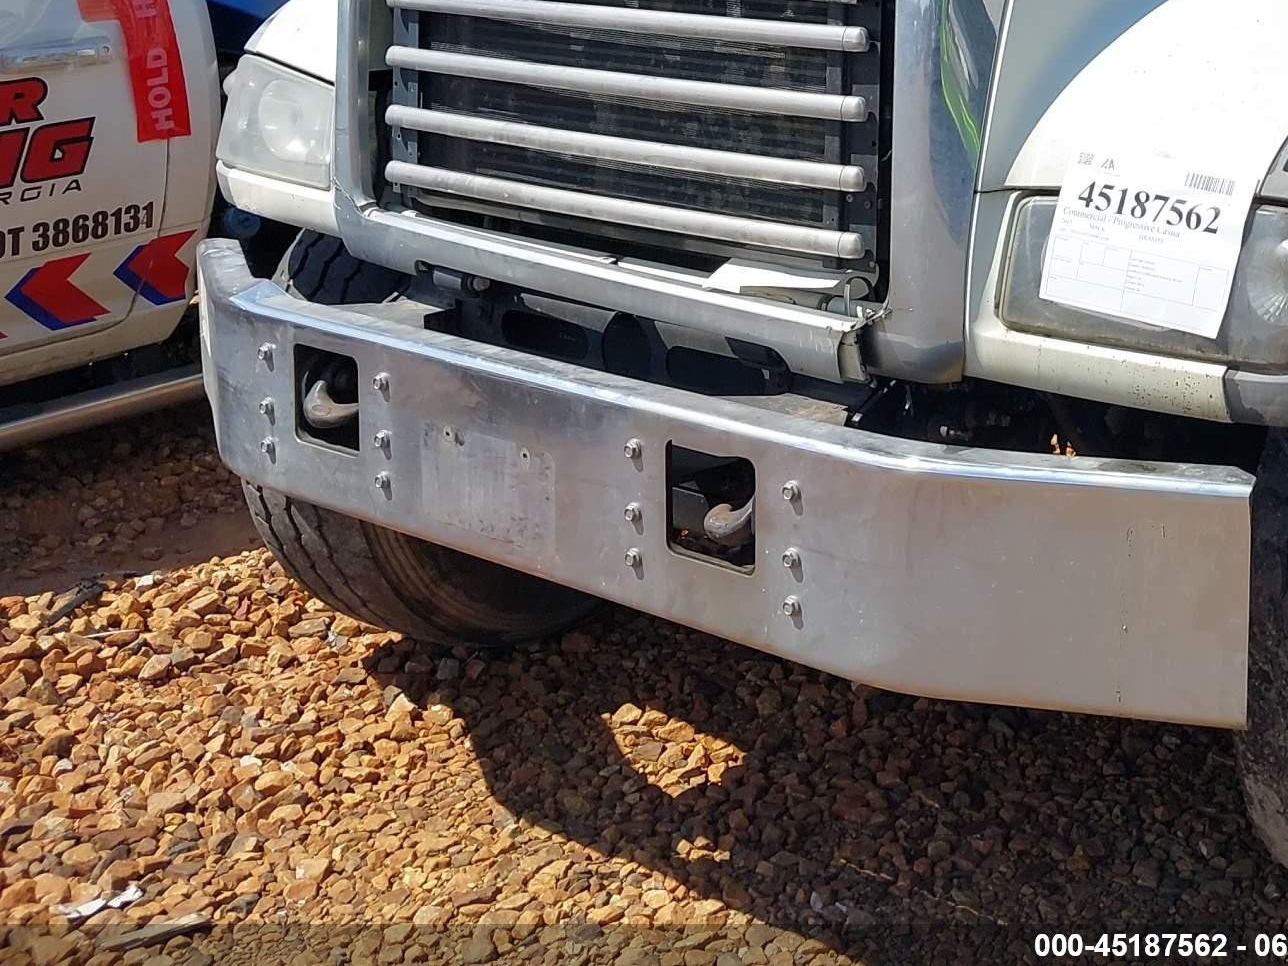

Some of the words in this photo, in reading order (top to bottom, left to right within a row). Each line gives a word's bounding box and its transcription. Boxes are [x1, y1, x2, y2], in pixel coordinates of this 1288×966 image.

[146, 47, 176, 131] HOLD
[32, 201, 154, 252] 3868131
[1063, 206, 1106, 223] Commercial
[1113, 215, 1156, 233] Progressive
[1078, 181, 1221, 234] 45187562
